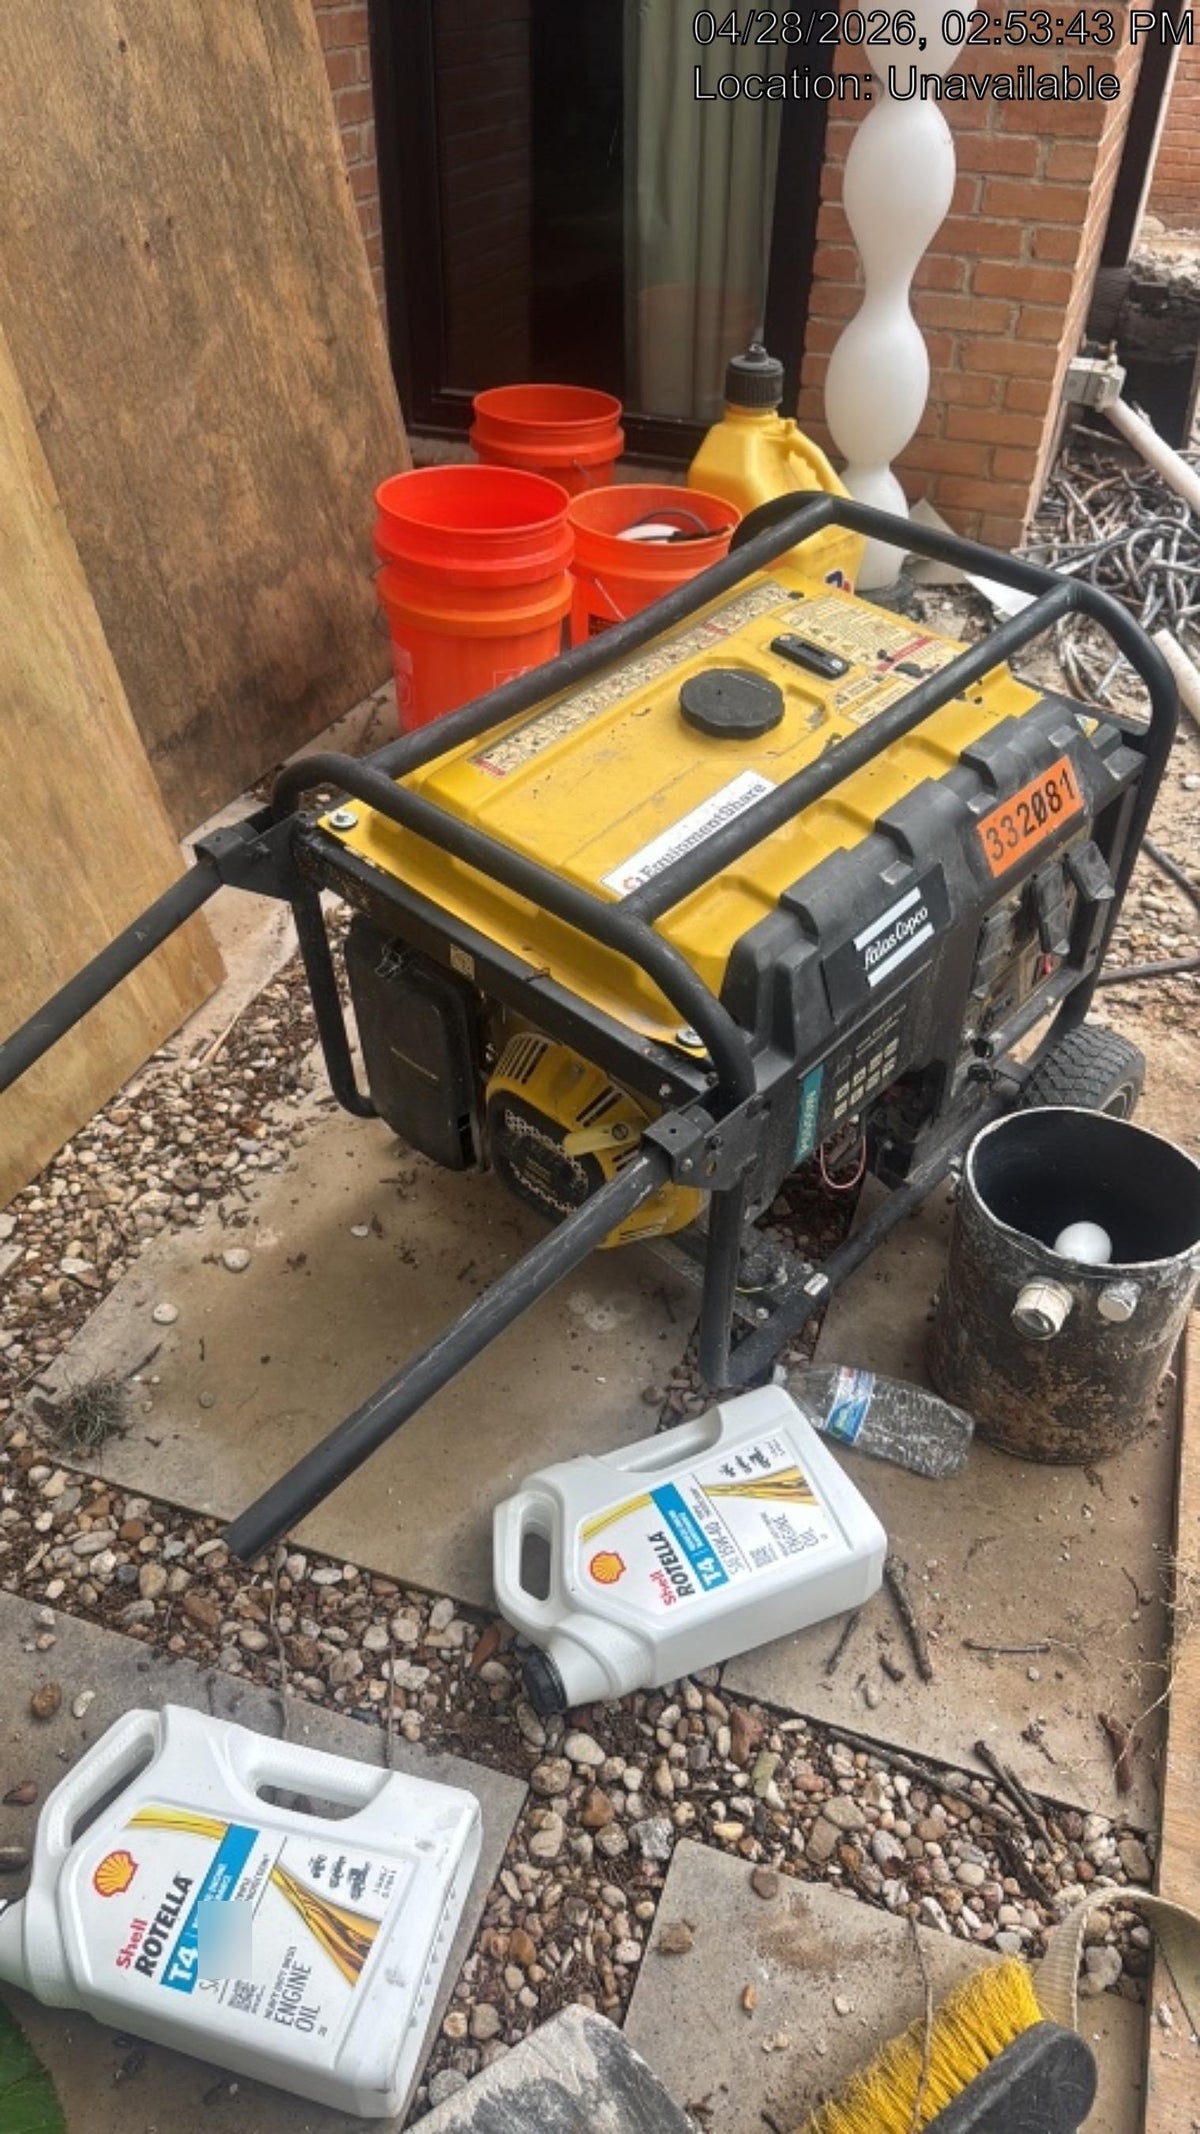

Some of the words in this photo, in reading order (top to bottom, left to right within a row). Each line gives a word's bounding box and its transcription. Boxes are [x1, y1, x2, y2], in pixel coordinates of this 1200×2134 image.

[986, 768, 1075, 861] 332081
[647, 1531, 695, 1597] ROTELLA
[650, 1570, 677, 1606] Shell
[697, 1557, 722, 1586] T4
[116, 1918, 147, 1969] Shell
[135, 1875, 193, 1978] ROTELLA
[168, 1946, 198, 1981] T4
[274, 1961, 311, 2027] ENGINE
[295, 2003, 321, 2033] OIL
